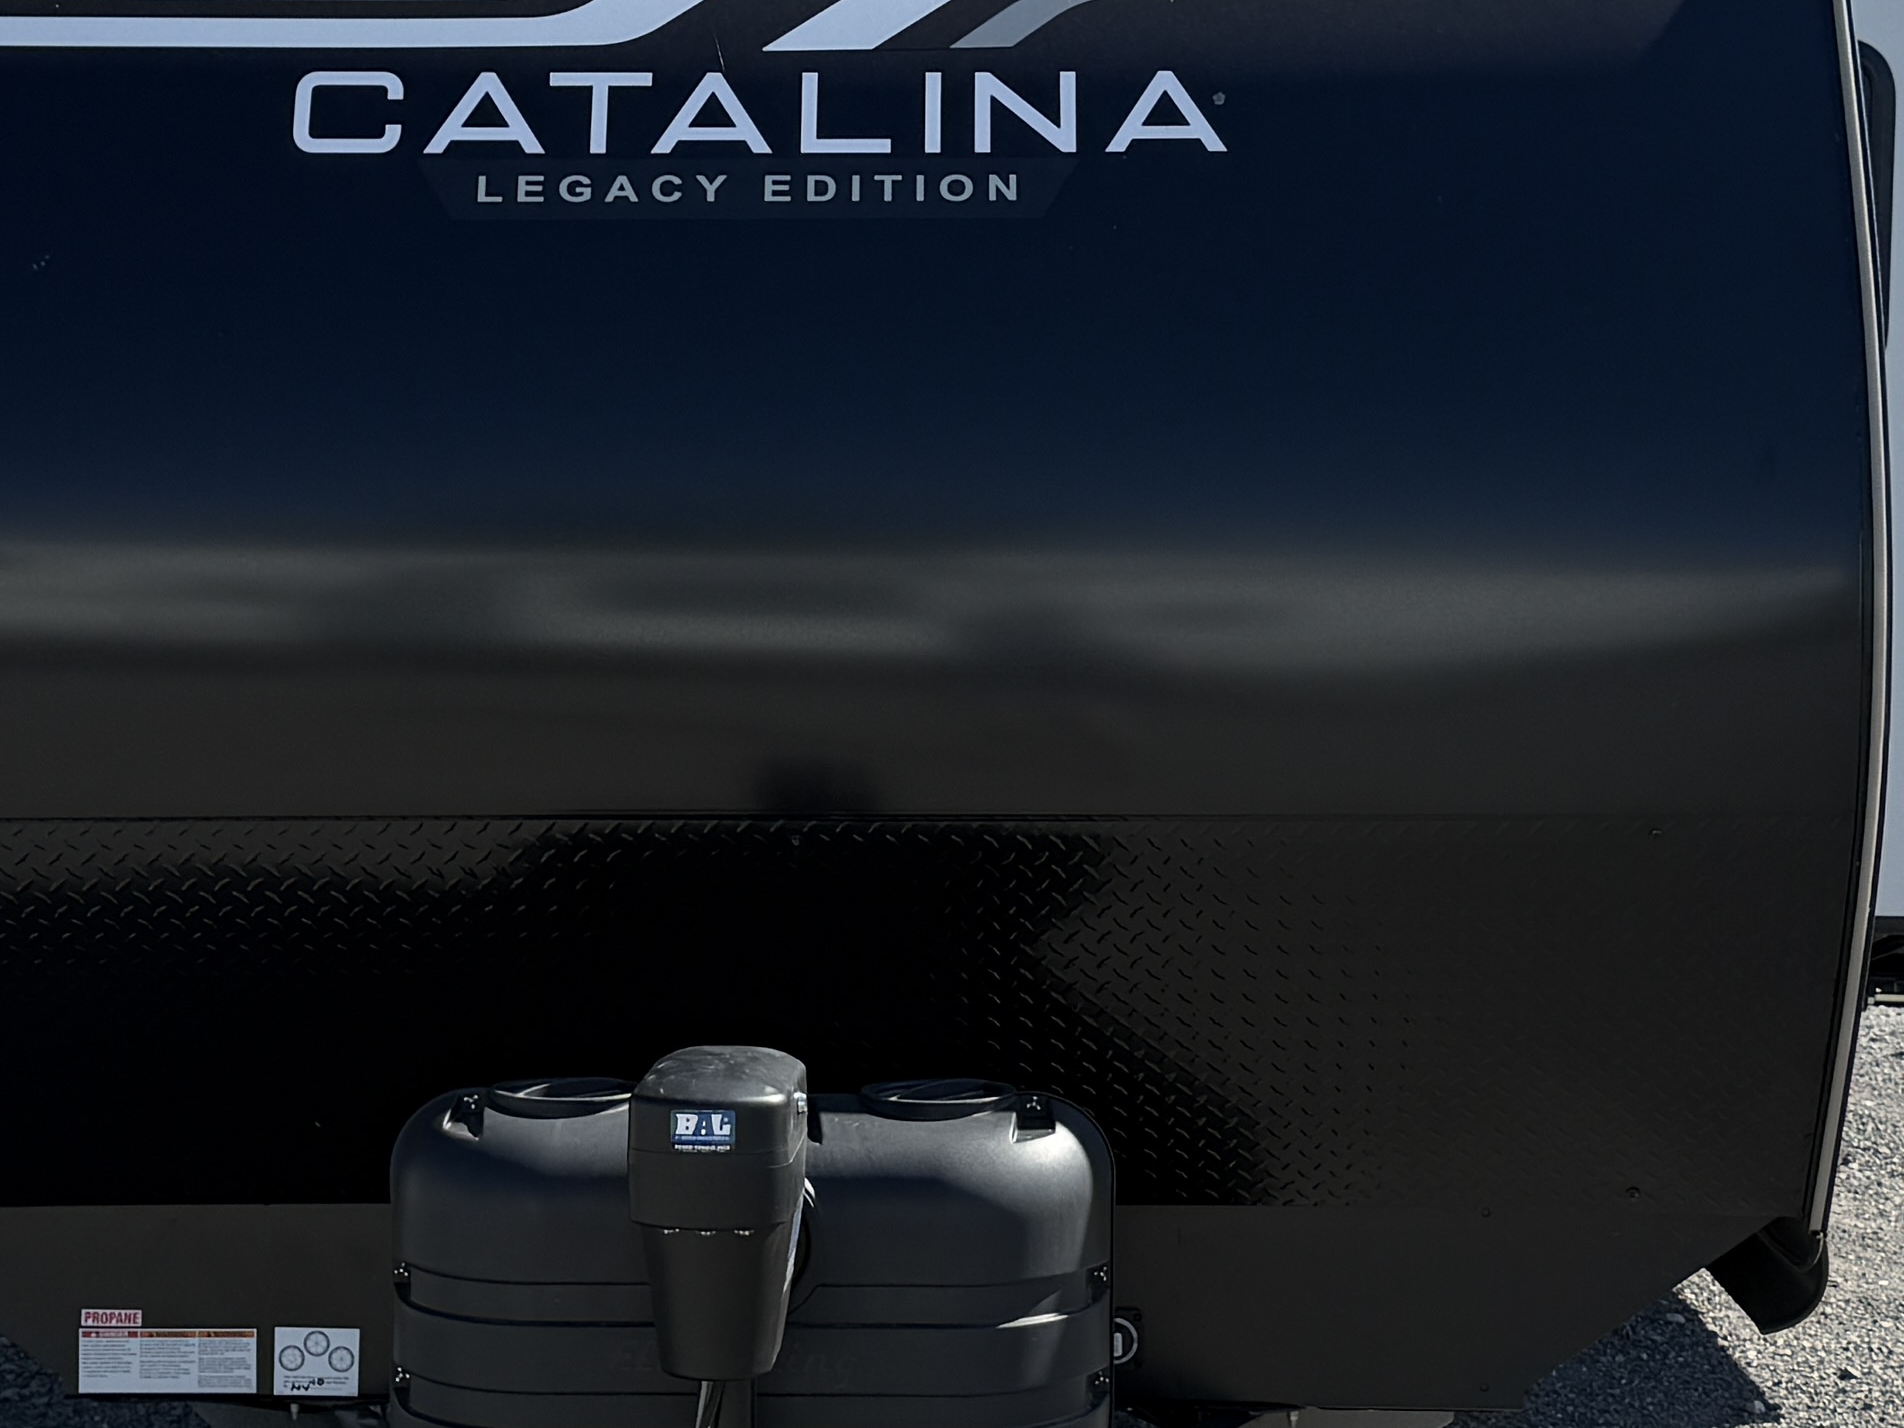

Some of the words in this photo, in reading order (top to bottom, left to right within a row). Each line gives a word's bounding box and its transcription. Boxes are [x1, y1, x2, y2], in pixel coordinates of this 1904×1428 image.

[292, 70, 1228, 154] CATALINA
[476, 174, 728, 203] LEGACY
[763, 173, 1018, 202] EDITION
[83, 1310, 140, 1325] PROPANE
